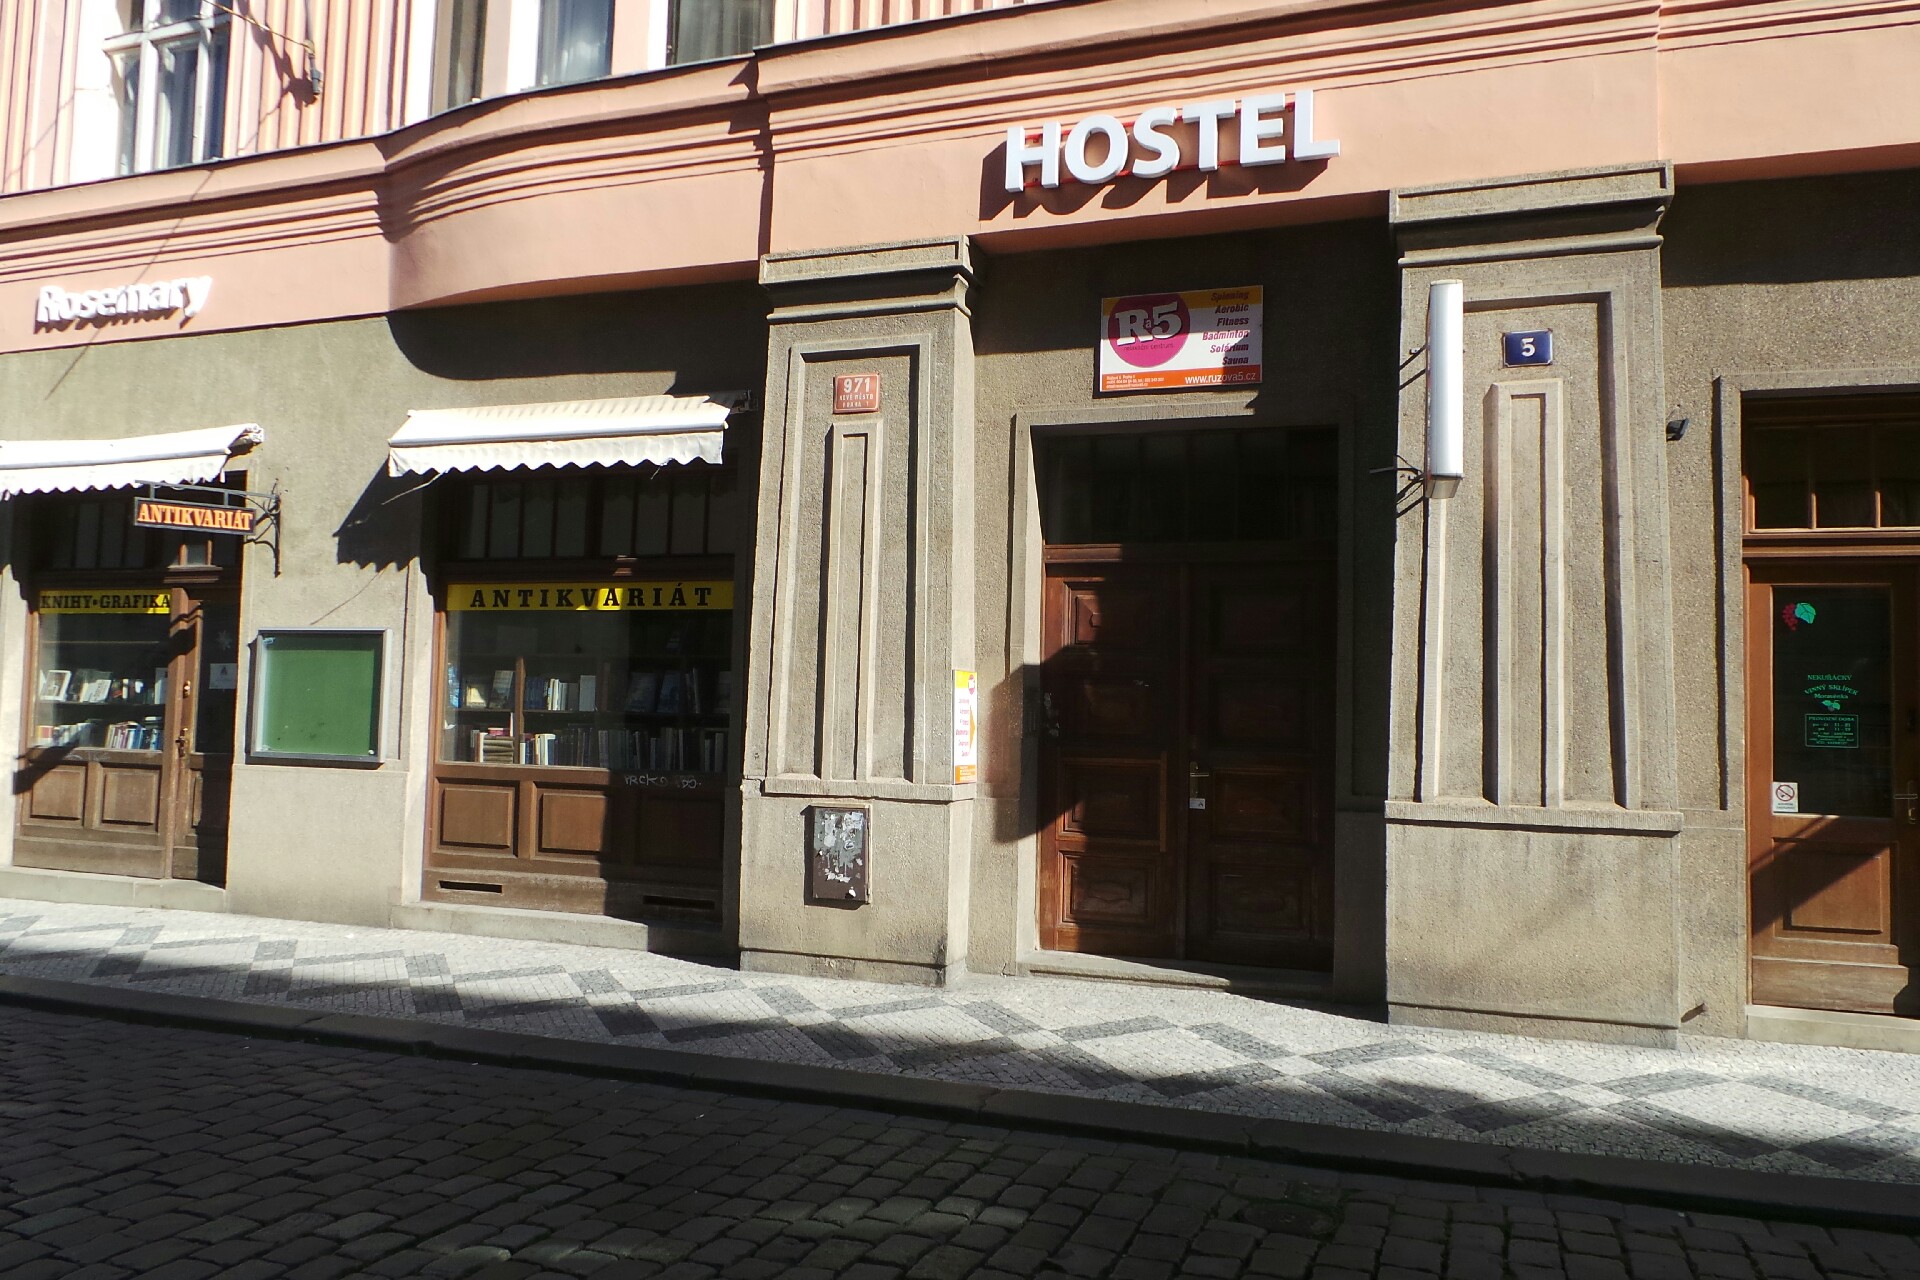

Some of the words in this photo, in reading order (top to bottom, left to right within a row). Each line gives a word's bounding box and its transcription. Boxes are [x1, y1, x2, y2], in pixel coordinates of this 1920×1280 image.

[1005, 89, 1340, 193] HOSTEL
[36, 275, 213, 323] Rosemary
[1211, 291, 1249, 303] Spinning
[1215, 304, 1249, 314] Aerobic
[1217, 317, 1249, 327] Fitness
[1202, 329, 1249, 341] Badminton
[1209, 342, 1249, 354] Solárium
[1521, 337, 1536, 357] 5
[1222, 356, 1249, 365] Sauna
[843, 377, 870, 393] 971
[1184, 371, 1256, 385] www.ruzova5.cz
[137, 503, 253, 531] ANTIKVARIÁT
[470, 583, 712, 608] ANTIKVARIÁT
